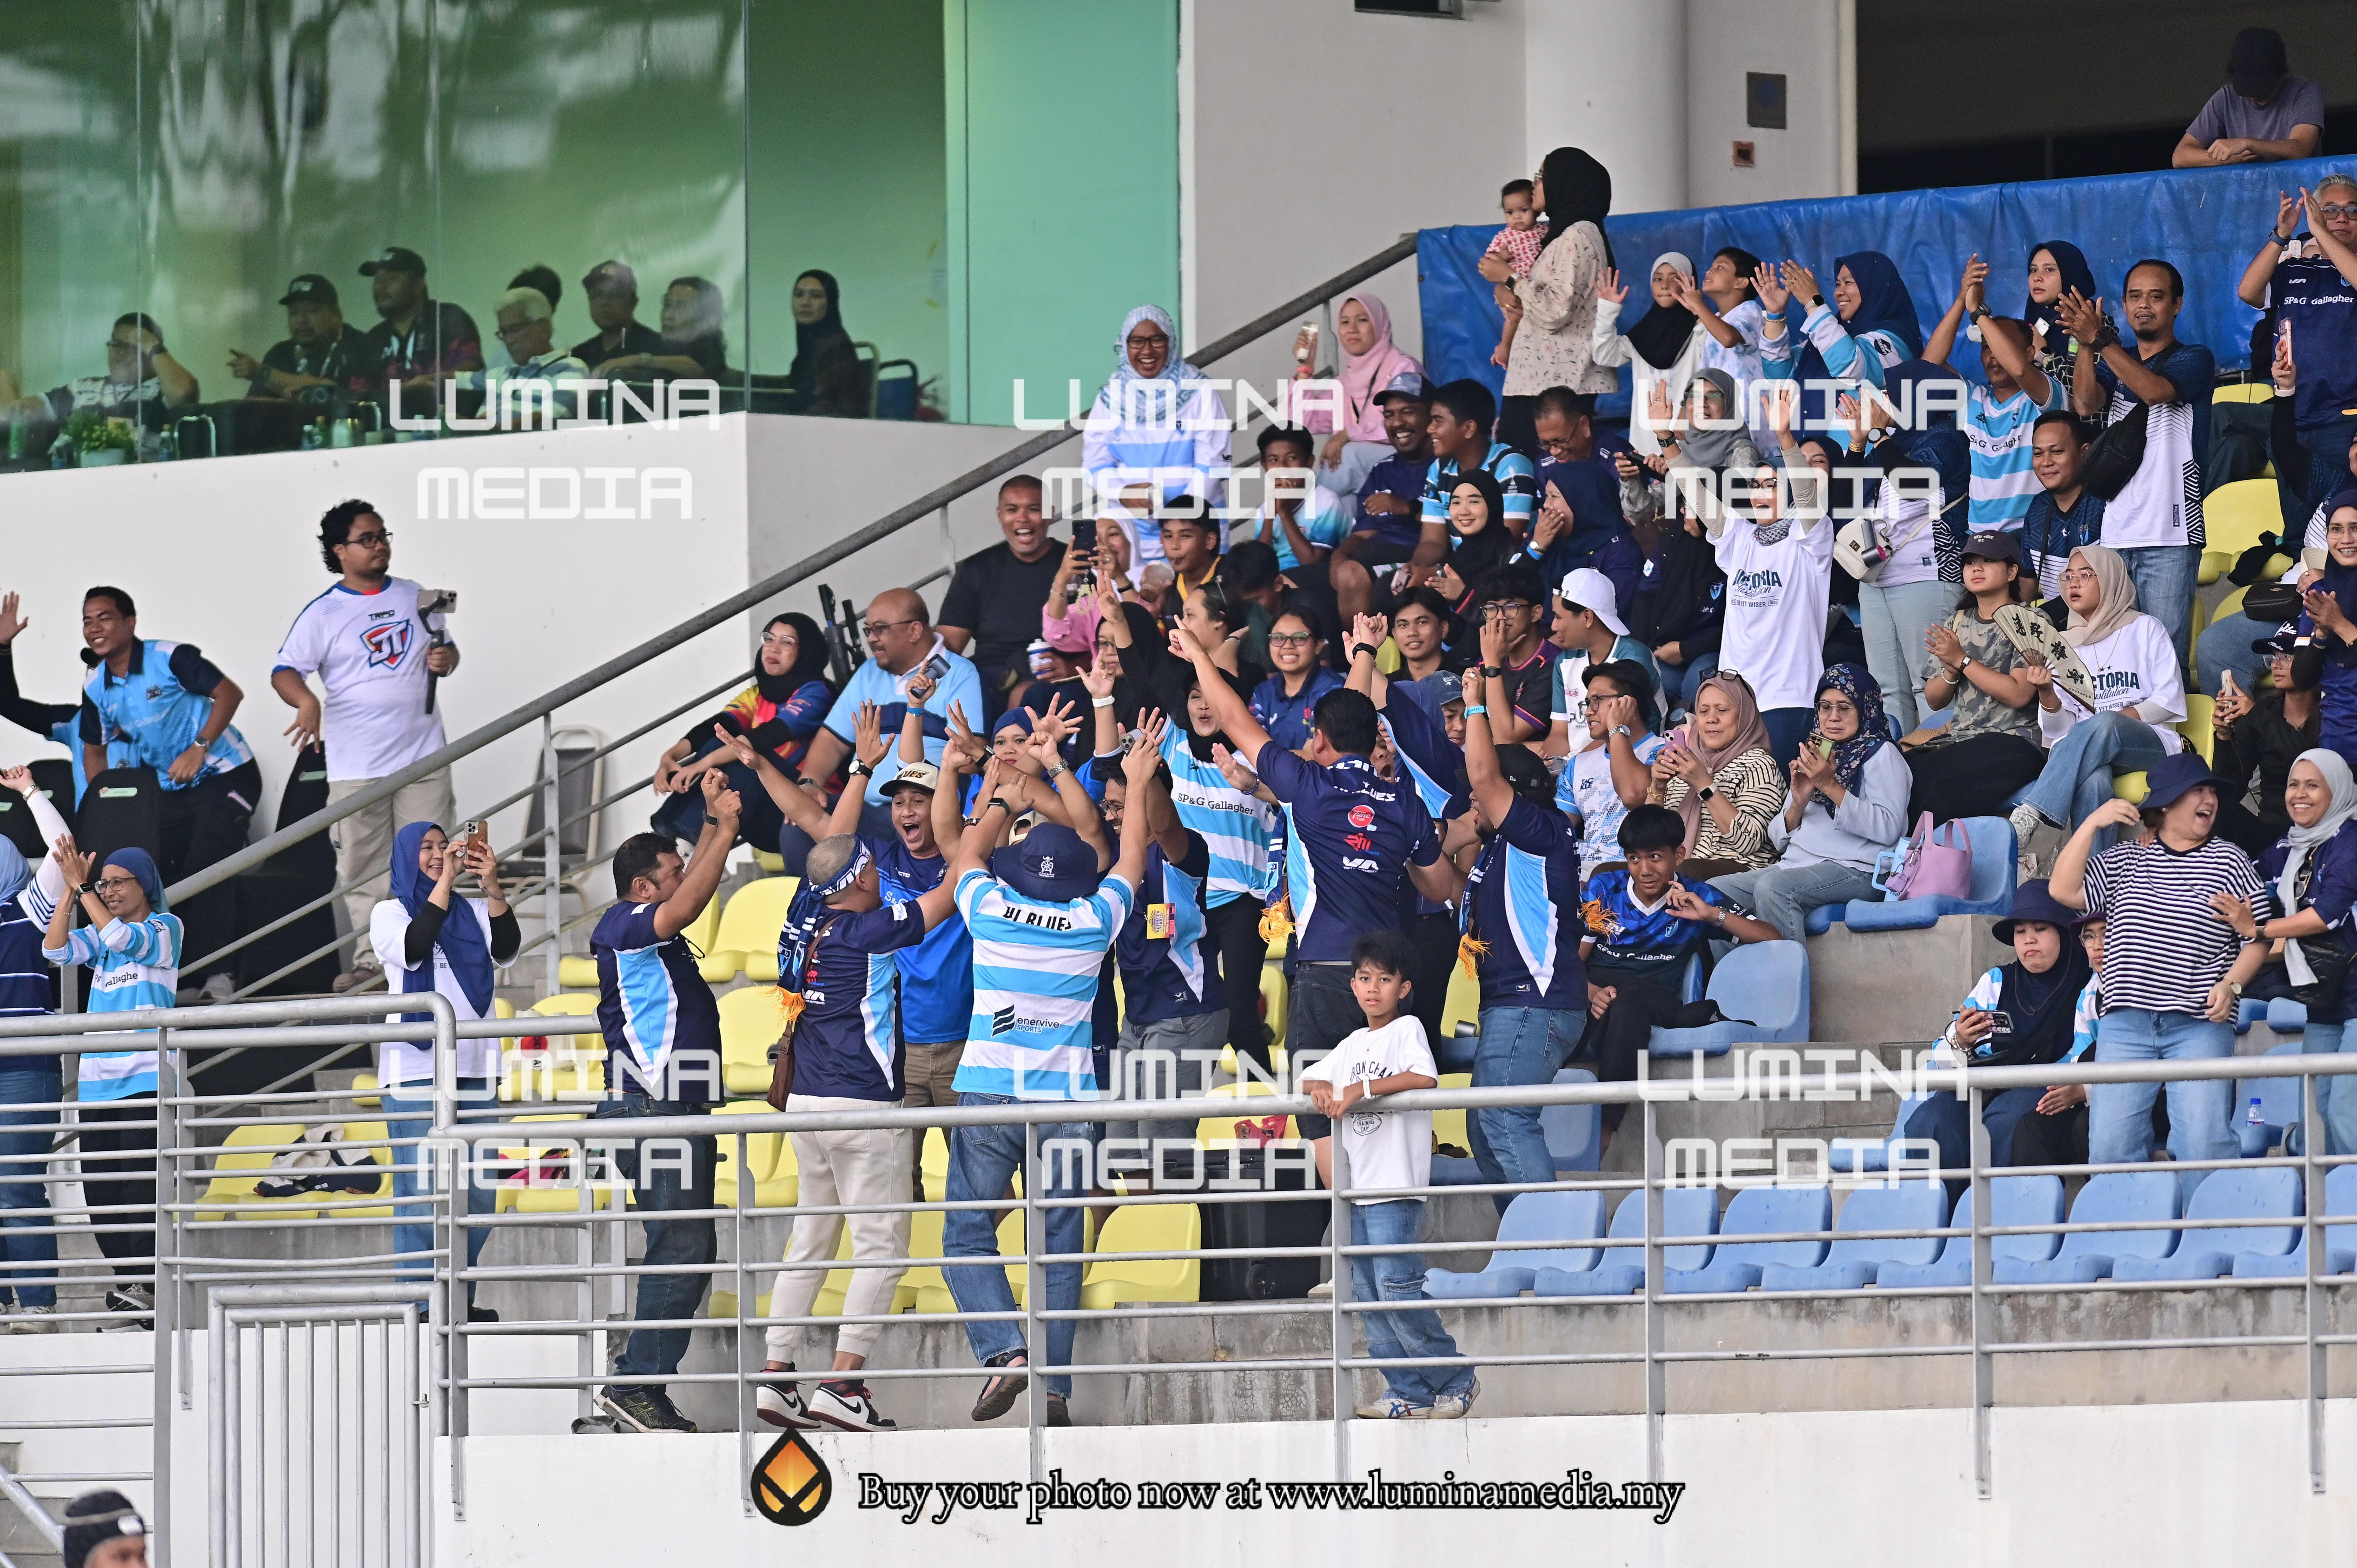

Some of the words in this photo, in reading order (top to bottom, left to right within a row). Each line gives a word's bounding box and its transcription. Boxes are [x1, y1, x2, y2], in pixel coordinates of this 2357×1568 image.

[2284, 297, 2307, 305] SP&G
[2311, 294, 2354, 305] Gallagher
[1178, 793, 1205, 806] SP&G
[1208, 801, 1254, 815] Gallagher
[1352, 810, 1371, 819] Tune
[1017, 1017, 1060, 1028] enervive
[1016, 1024, 1042, 1033] SPORTS
